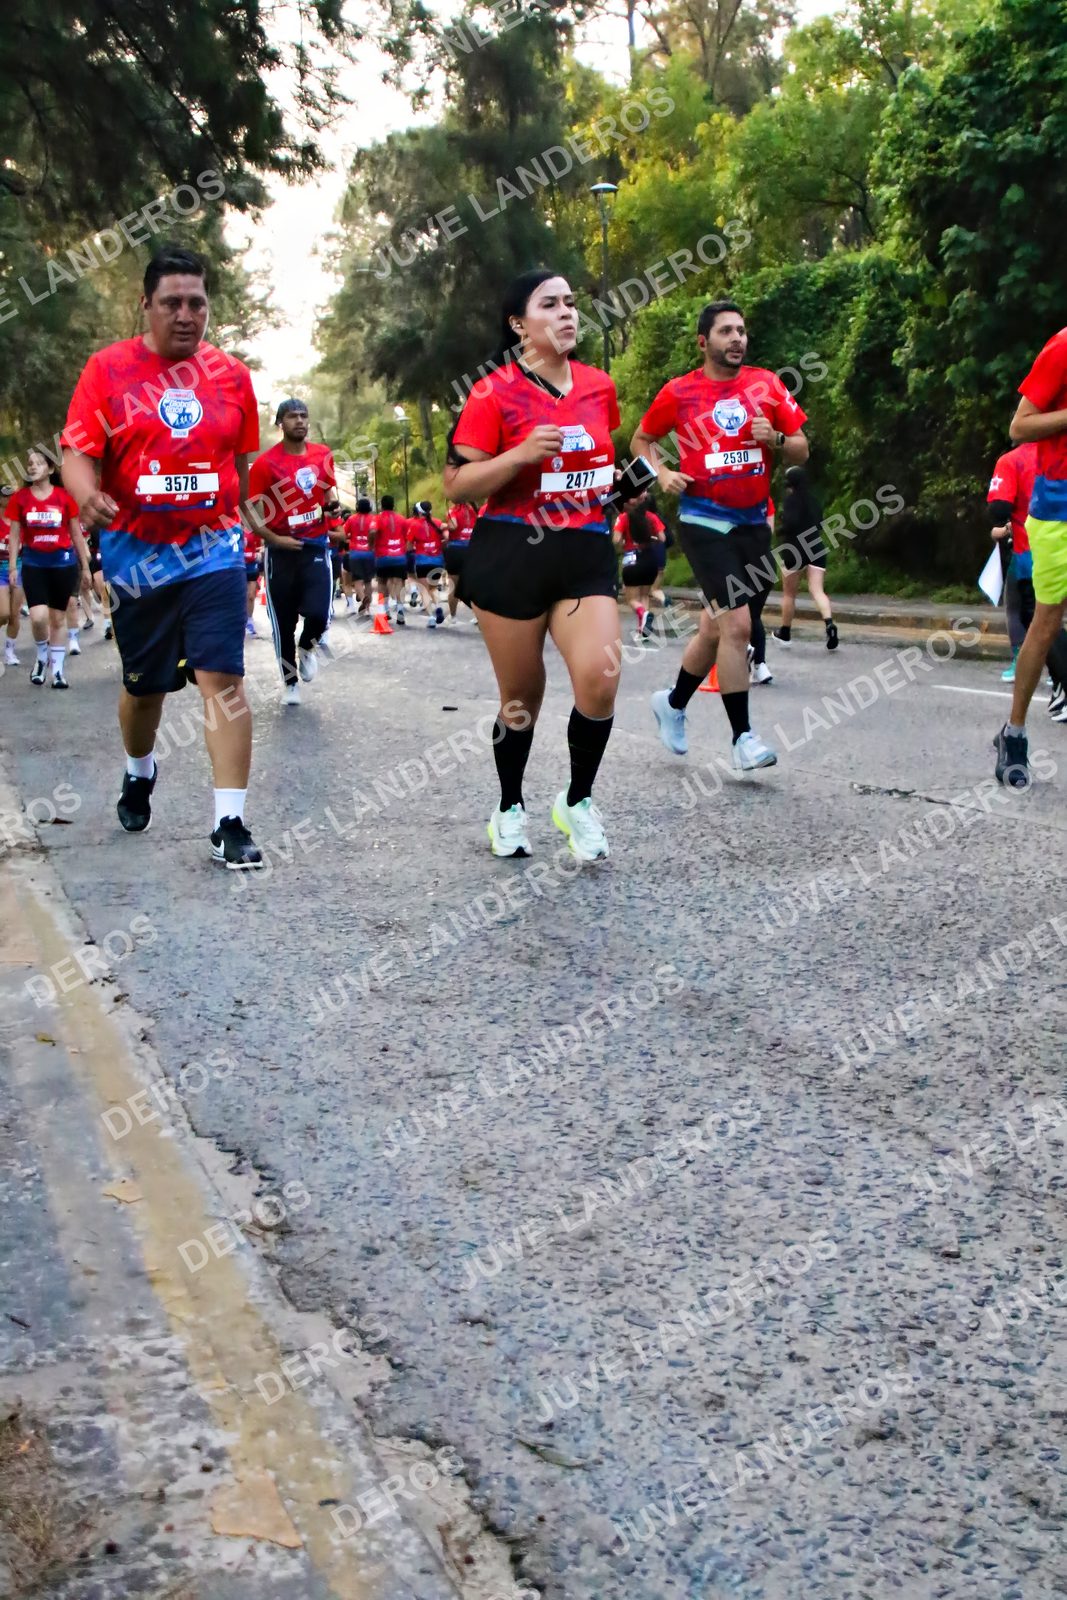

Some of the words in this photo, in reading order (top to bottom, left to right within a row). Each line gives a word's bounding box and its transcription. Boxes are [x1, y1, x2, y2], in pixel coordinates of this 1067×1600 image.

[723, 451, 749, 465] 2530
[165, 476, 198, 492] 3578
[566, 471, 595, 489] 2477
